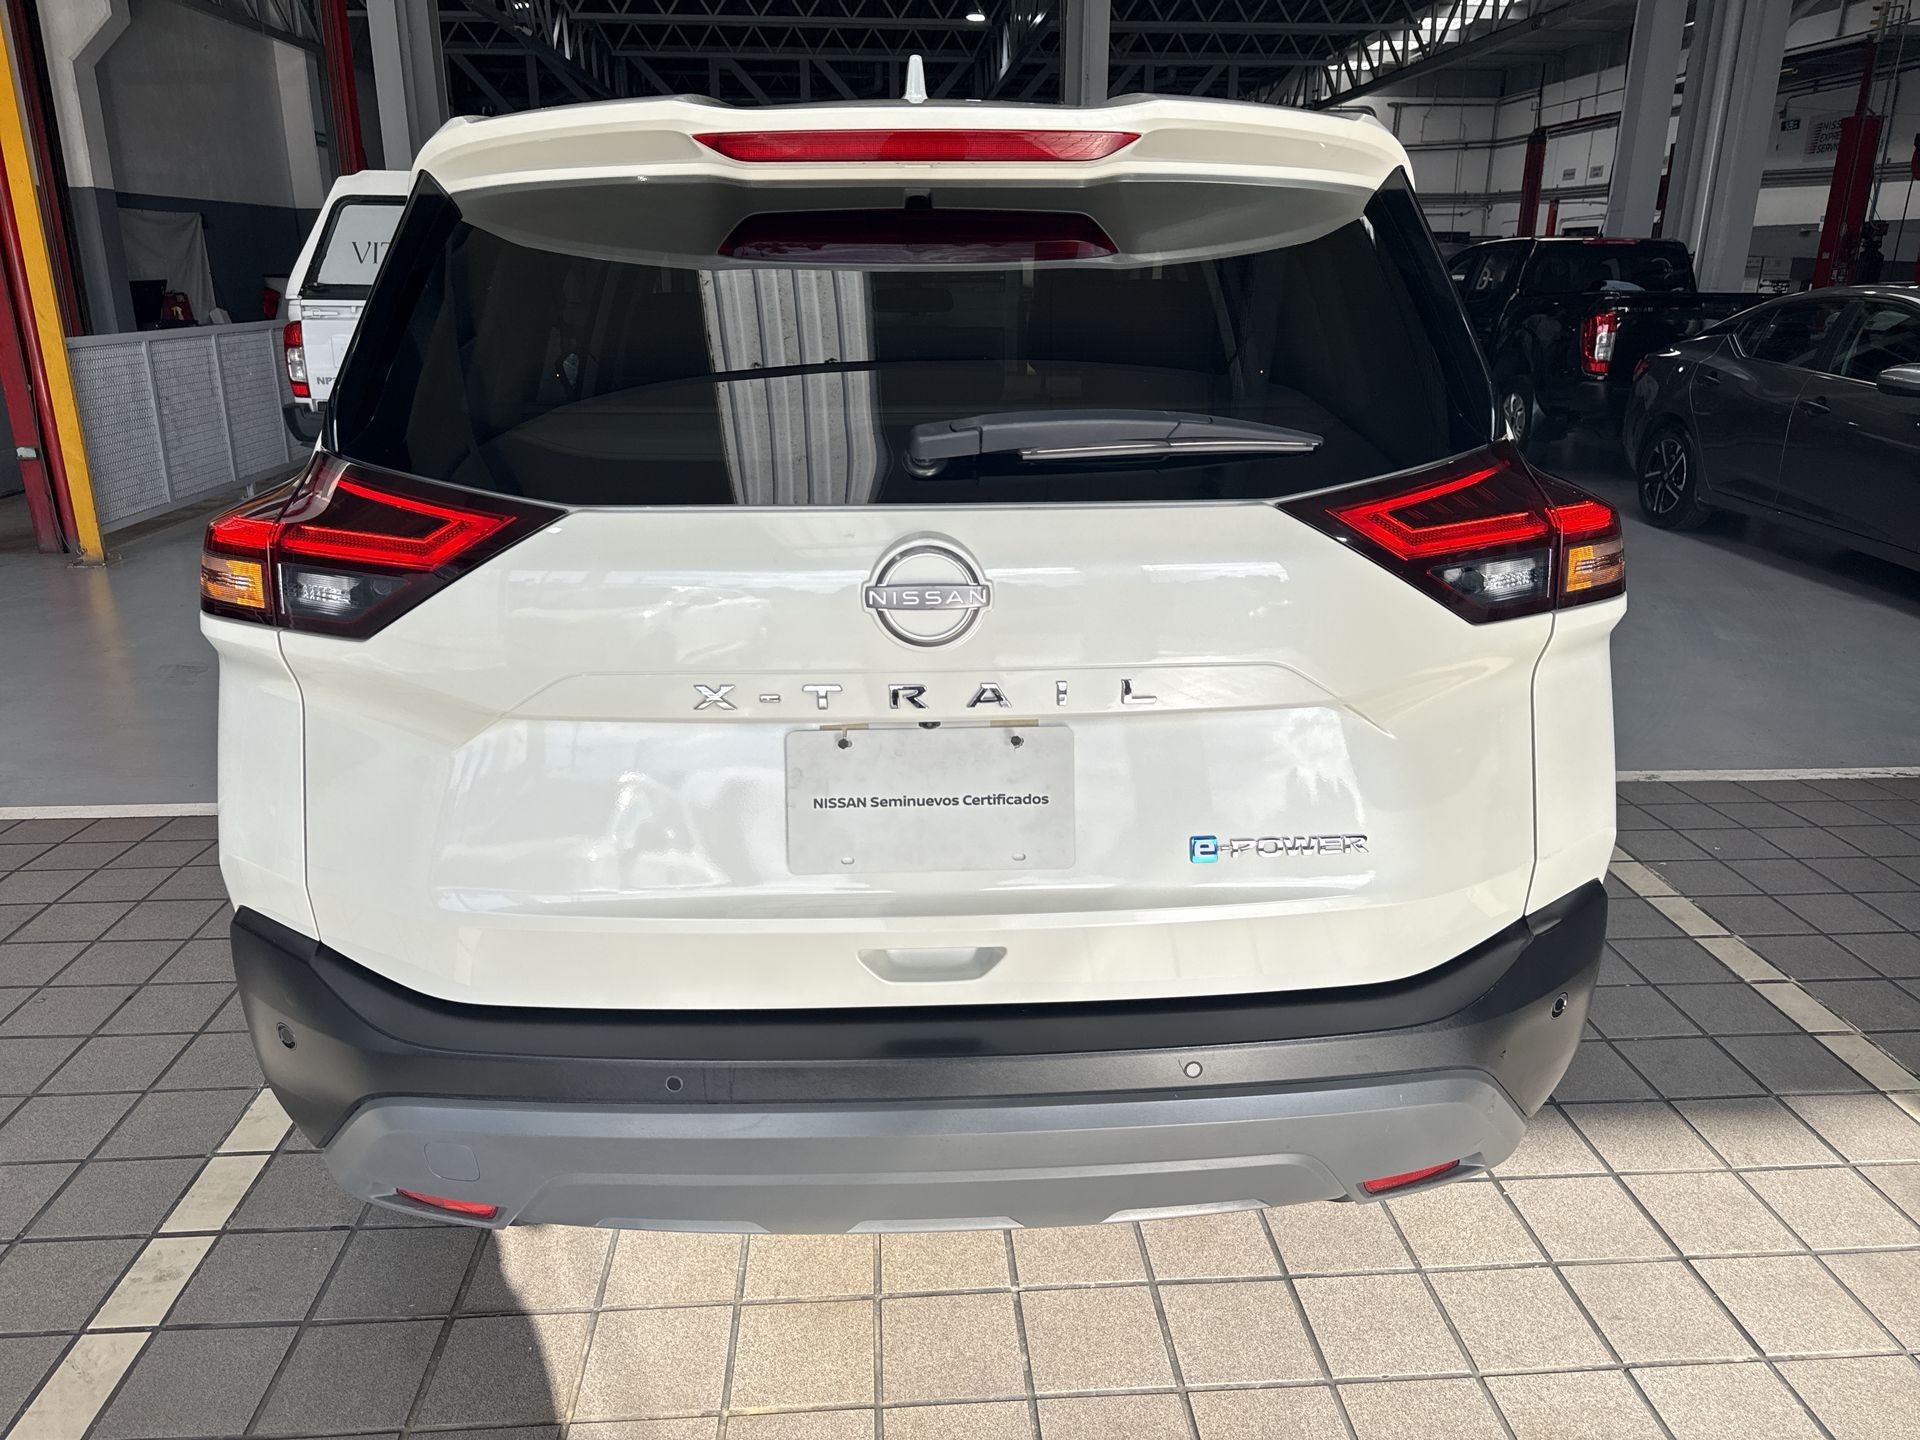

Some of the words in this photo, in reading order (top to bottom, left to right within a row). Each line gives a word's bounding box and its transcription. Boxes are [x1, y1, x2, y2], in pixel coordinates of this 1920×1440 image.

[868, 589, 987, 605] NISSAN
[693, 678, 1158, 710] X-TRAIL
[813, 797, 867, 808] NISSAN
[870, 795, 959, 808] Seminuevos
[962, 793, 1049, 806] Certificados
[1190, 835, 1369, 863] e-POWER
